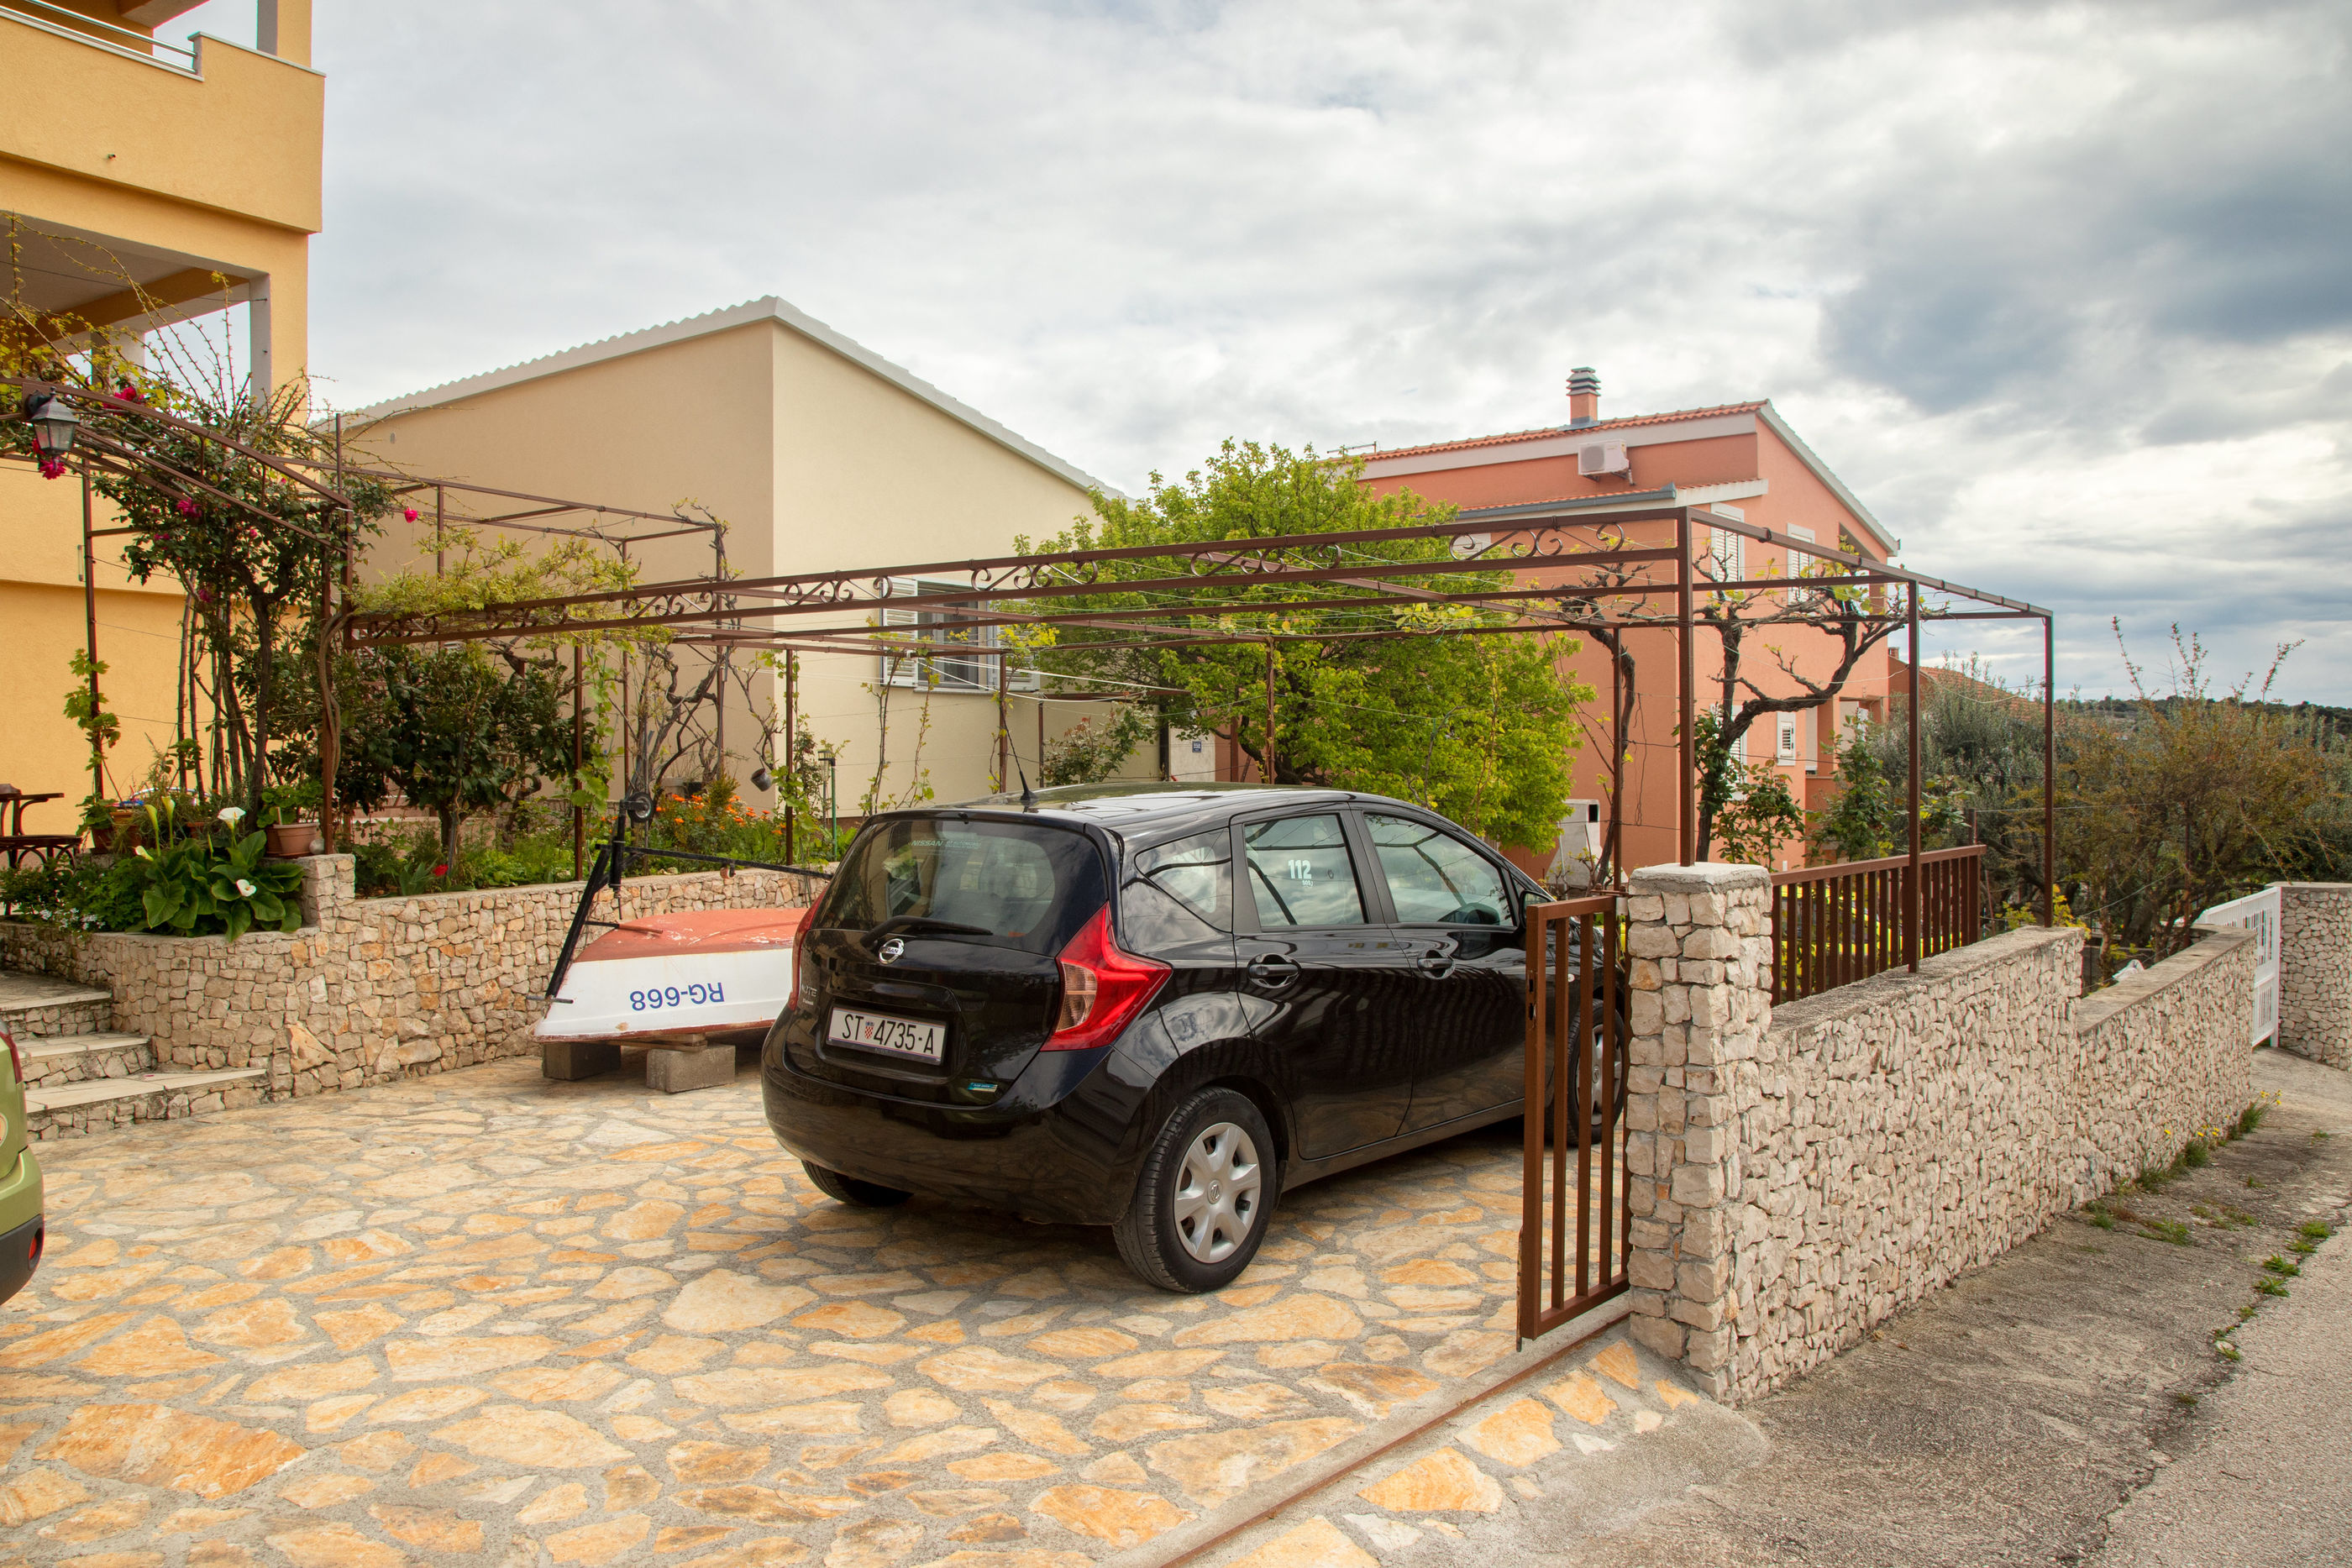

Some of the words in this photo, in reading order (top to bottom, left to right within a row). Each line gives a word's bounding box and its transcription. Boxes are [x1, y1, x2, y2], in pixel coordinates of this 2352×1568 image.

[1288, 859, 1312, 879] 112
[629, 982, 724, 1011] RG-668
[842, 1014, 864, 1040] ST
[873, 1020, 933, 1054] 4735-A
